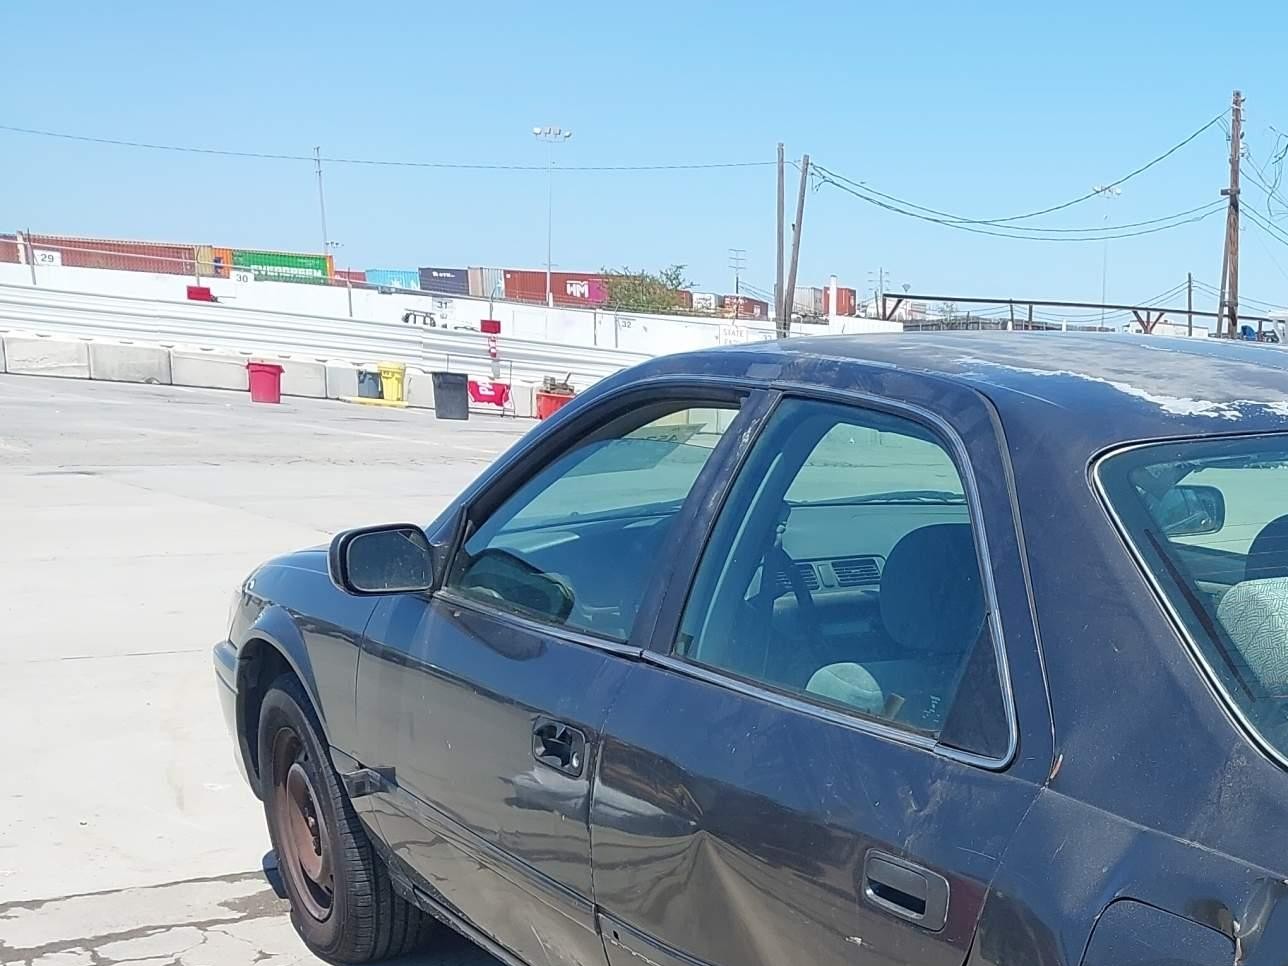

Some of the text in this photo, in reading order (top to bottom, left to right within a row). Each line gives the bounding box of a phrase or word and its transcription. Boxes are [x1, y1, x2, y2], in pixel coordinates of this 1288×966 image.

[40, 253, 54, 263] 29
[235, 273, 249, 283] 30
[436, 300, 448, 309] 31
[621, 320, 632, 328] 32
